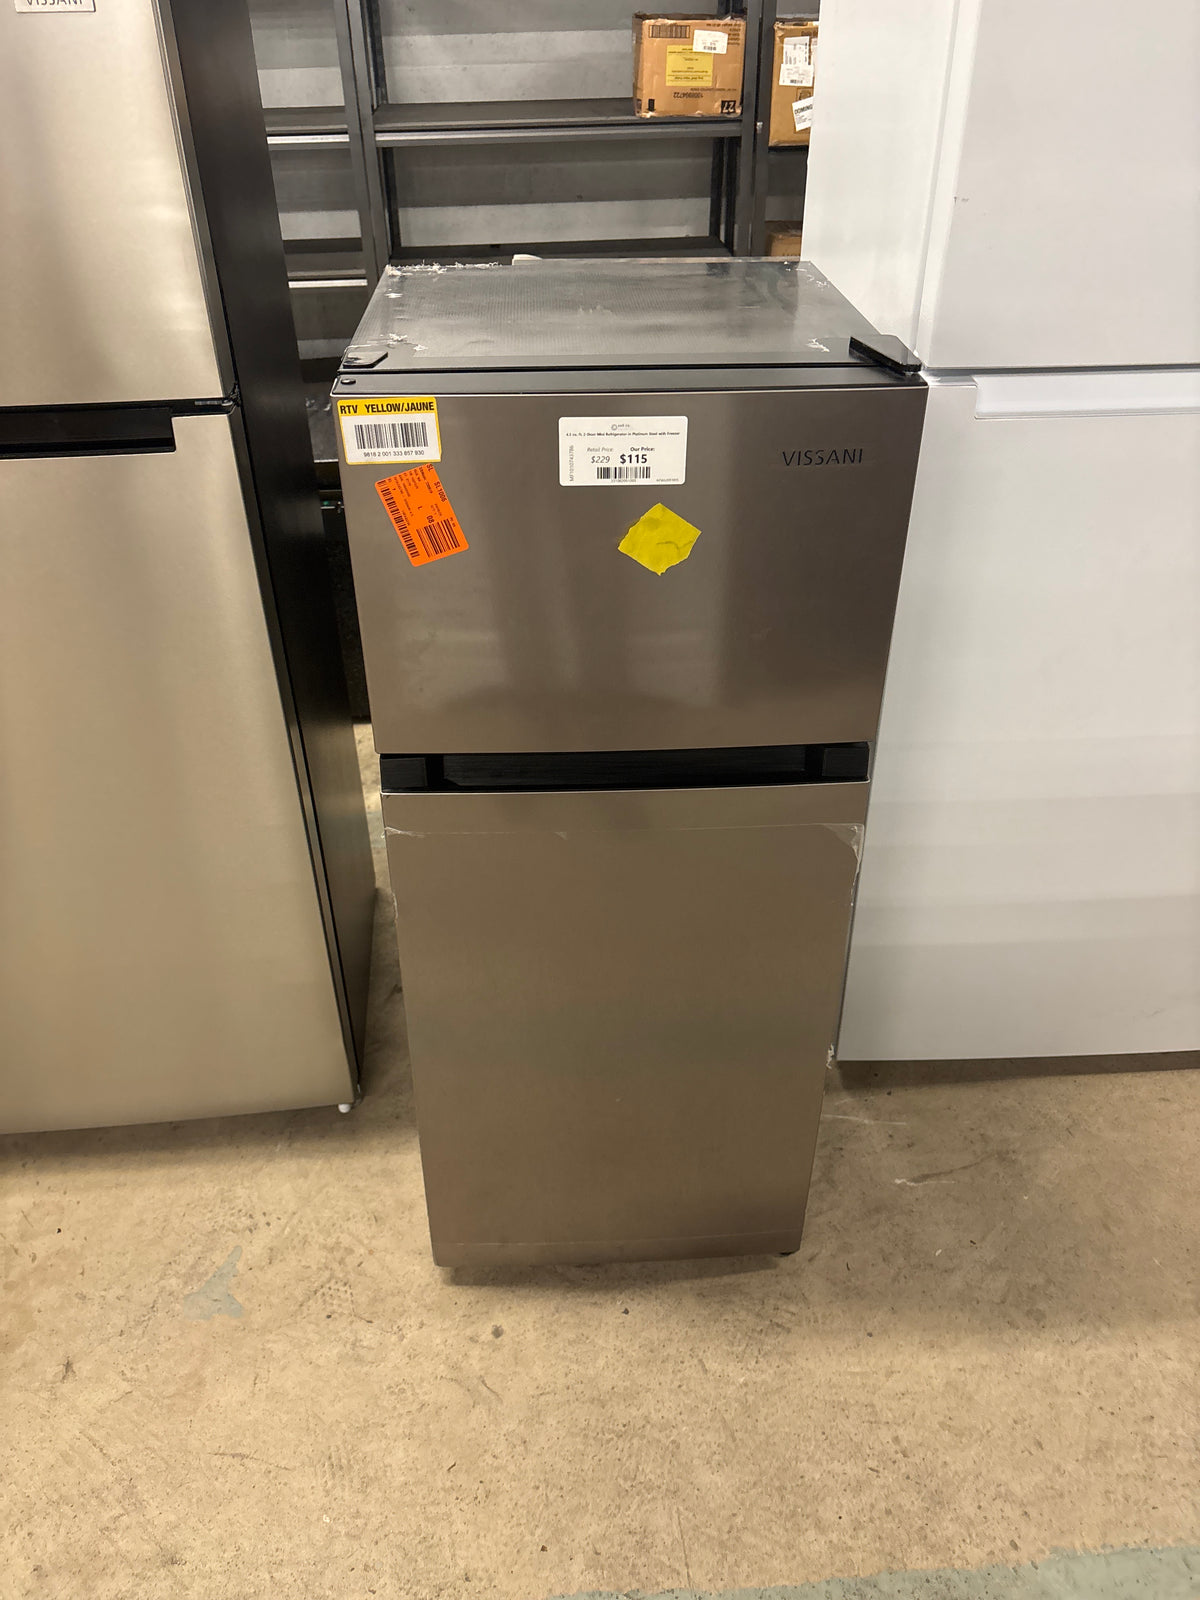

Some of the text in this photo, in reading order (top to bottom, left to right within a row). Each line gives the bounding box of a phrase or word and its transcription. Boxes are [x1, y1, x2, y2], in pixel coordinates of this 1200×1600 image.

[722, 101, 736, 113] 27
[340, 401, 435, 414] RTV YELLOW/JAUNE
[591, 455, 610, 464] $229
[619, 453, 648, 464] $115
[782, 448, 863, 466] VISSANI
[426, 515, 435, 524] 08
